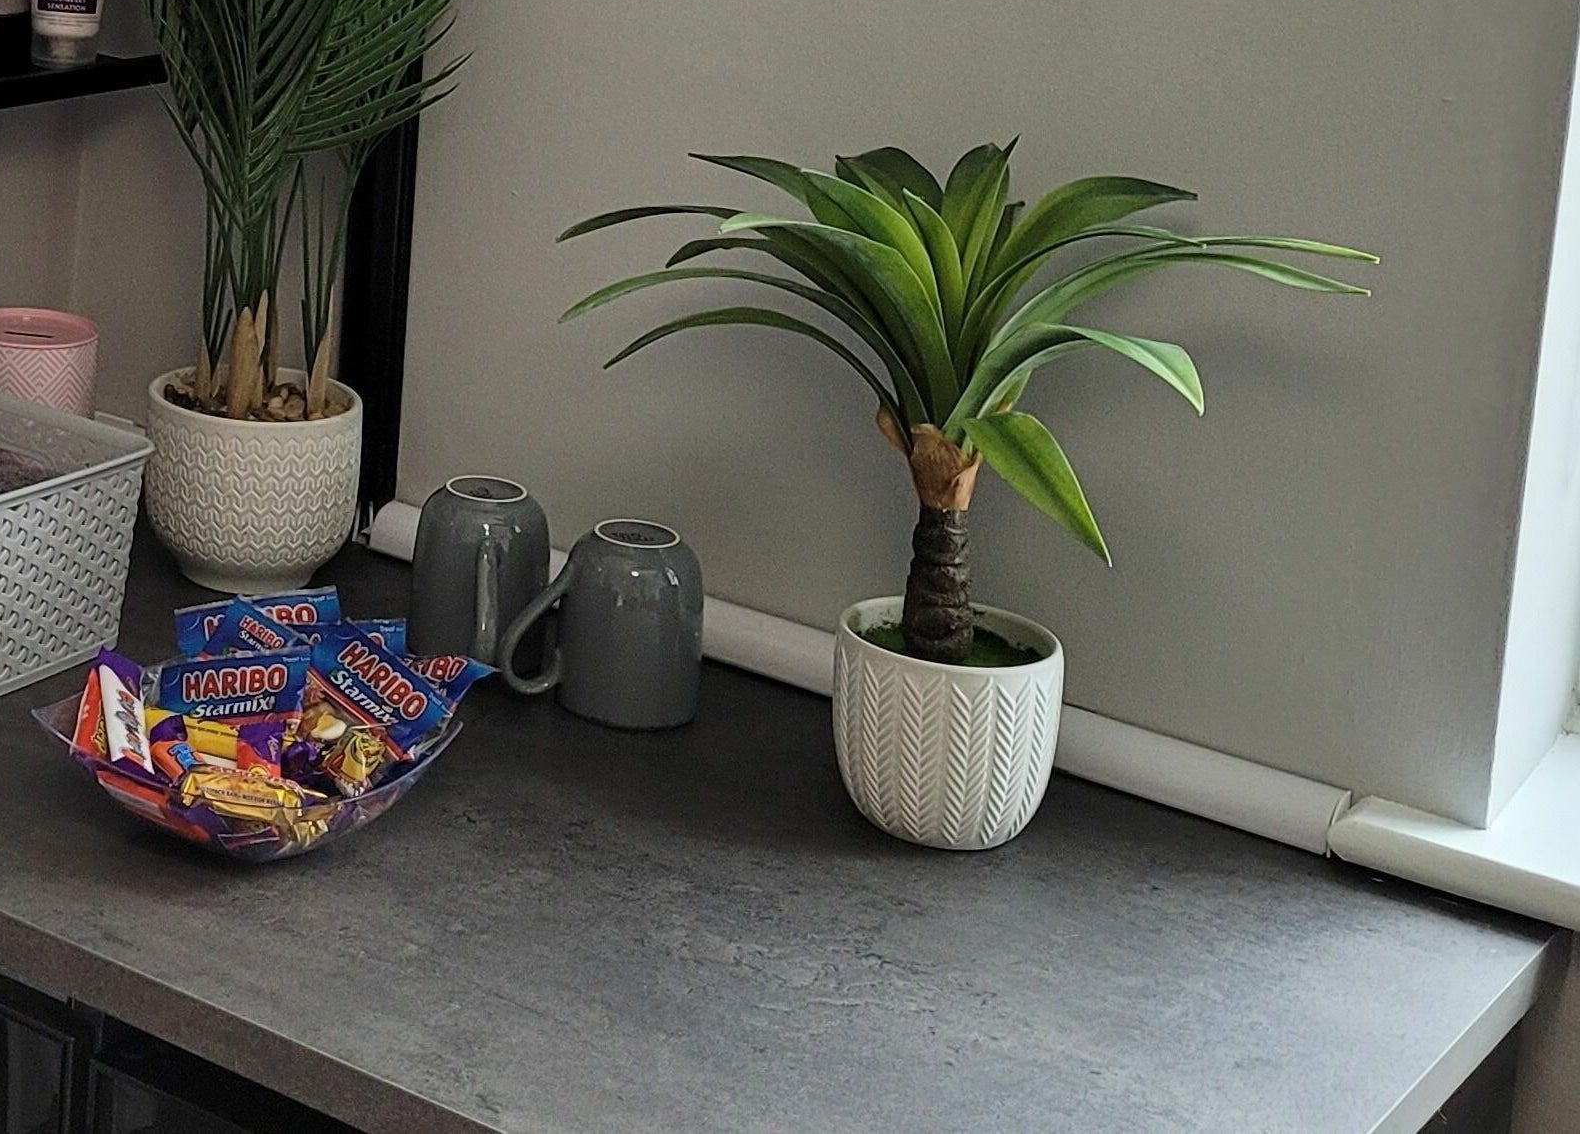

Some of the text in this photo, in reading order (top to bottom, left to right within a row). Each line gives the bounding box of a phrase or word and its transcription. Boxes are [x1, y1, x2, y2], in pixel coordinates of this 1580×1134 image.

[47, 2, 87, 12] SENSATION
[240, 615, 284, 649] HARIBO
[183, 664, 287, 703] HARIBO
[338, 641, 427, 720] HARIBO
